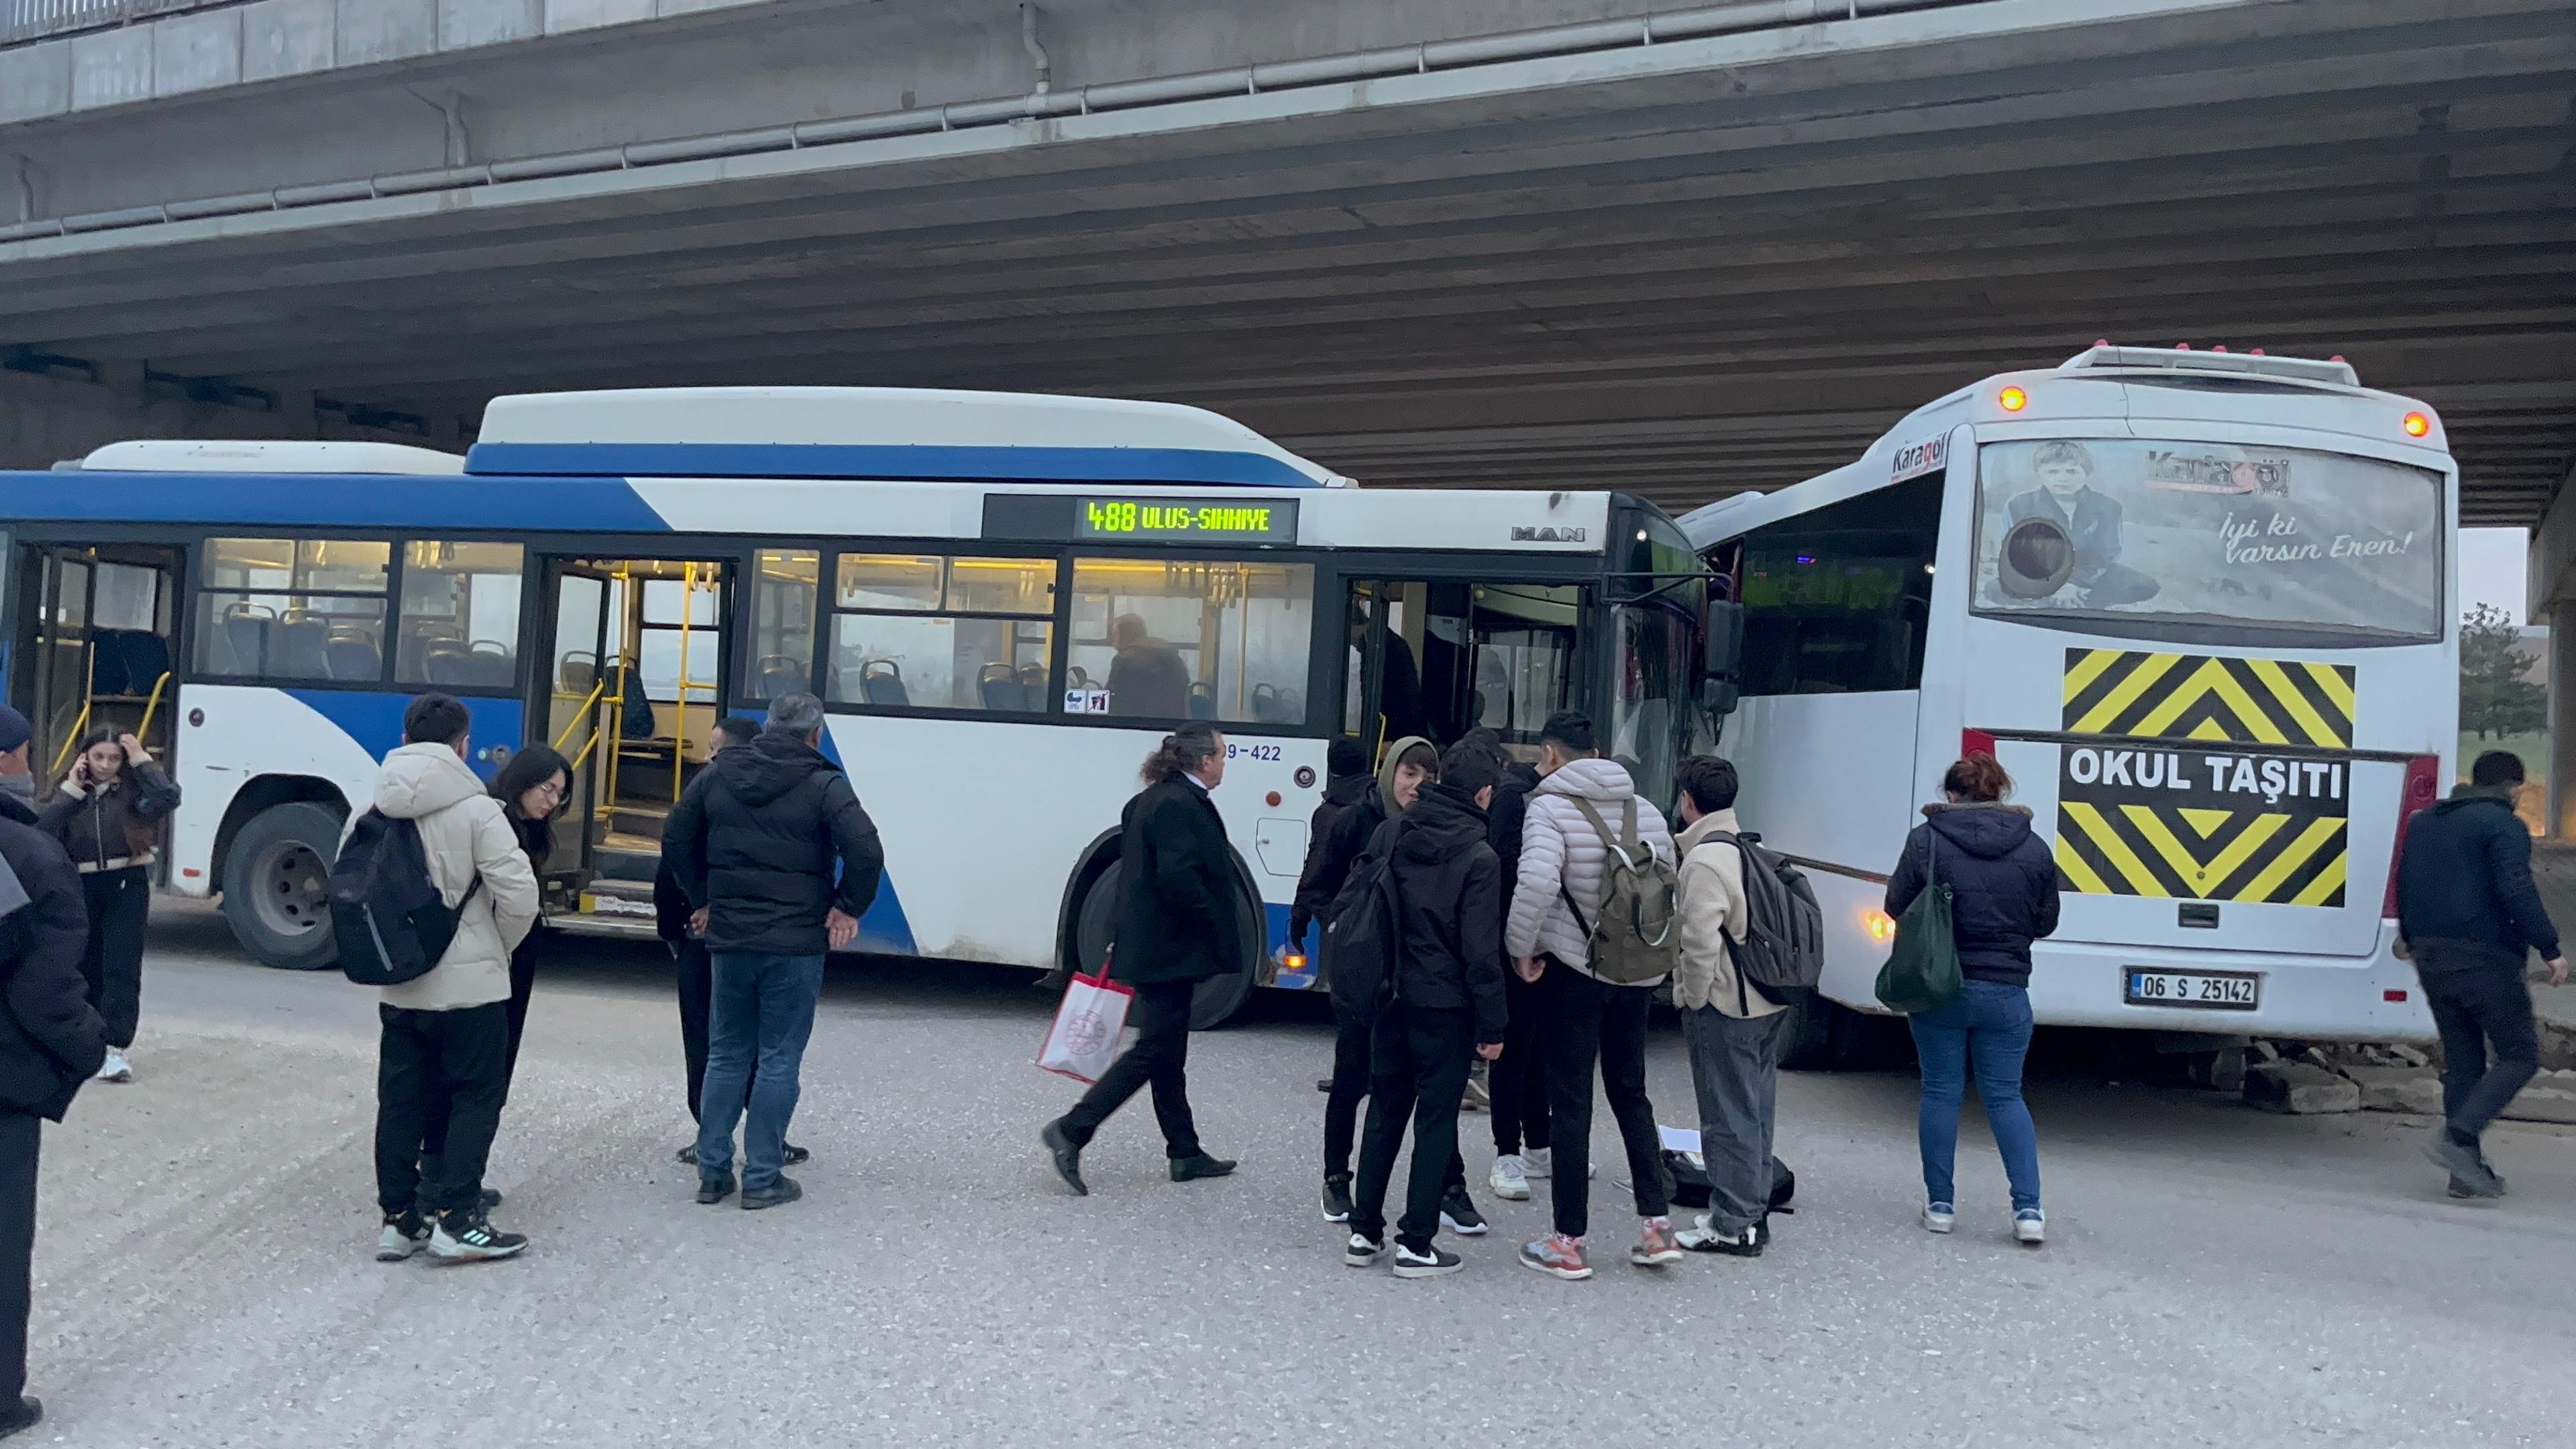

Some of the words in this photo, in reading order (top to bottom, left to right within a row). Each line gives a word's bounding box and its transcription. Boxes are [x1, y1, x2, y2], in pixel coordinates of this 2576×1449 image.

[1088, 502, 1136, 531] 488
[1511, 526, 1585, 542] MAN
[2219, 512, 2259, 549] İyi
[2267, 513, 2298, 536] ki
[1222, 743, 1281, 761] 9-422
[2069, 749, 2191, 790] OKUL
[2205, 756, 2342, 804] TAŞITI
[2144, 977, 2165, 997] 06
[2178, 977, 2188, 998] S
[2200, 979, 2252, 1002] 25142
